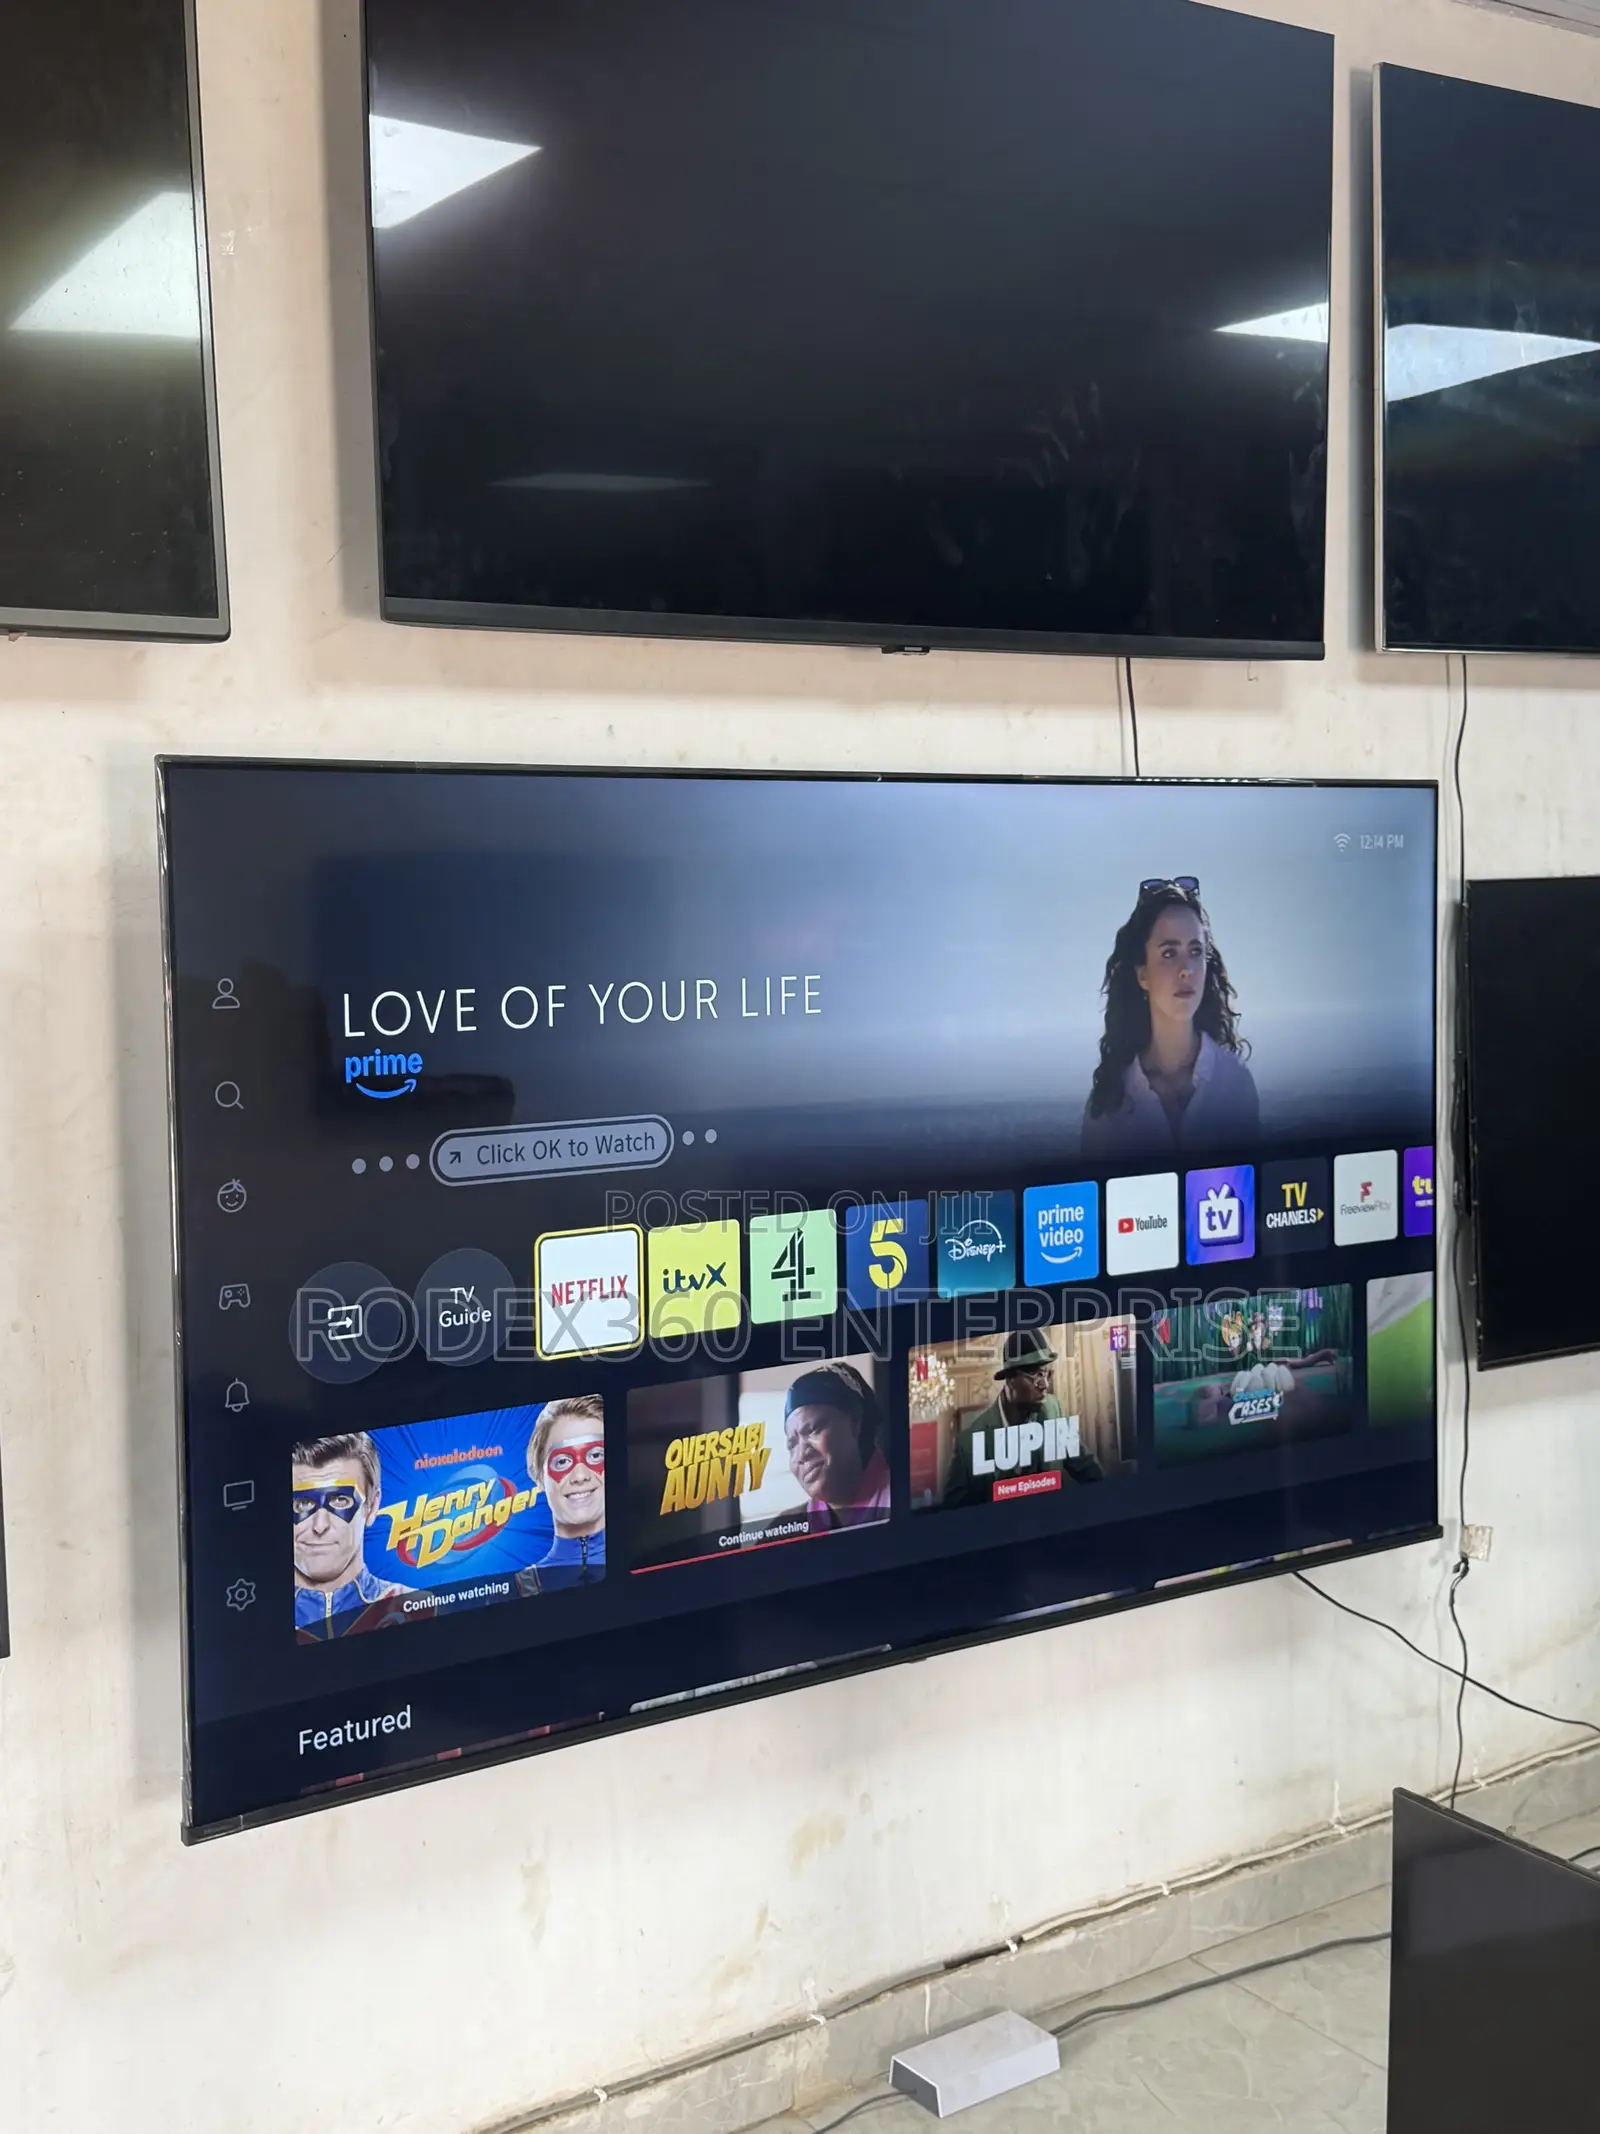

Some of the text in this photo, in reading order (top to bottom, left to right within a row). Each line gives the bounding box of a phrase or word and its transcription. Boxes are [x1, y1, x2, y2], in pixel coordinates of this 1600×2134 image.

[1360, 833, 1404, 850] 12:14 PM
[343, 974, 822, 1037] LOVE OF YOUR LIFE
[344, 1048, 424, 1083] prime
[476, 1131, 656, 1166] Click OK to Watch
[1281, 1181, 1308, 1208] TV
[1038, 1203, 1085, 1228] prime
[1135, 1214, 1168, 1232] YouTube
[1205, 1206, 1233, 1232] tv
[1266, 1208, 1317, 1229] CHANNELS
[1039, 1226, 1084, 1248] video
[771, 1227, 816, 1303] 4
[868, 1217, 908, 1290] 5
[551, 1274, 629, 1308] NETFLIX
[663, 1261, 727, 1295] itvX
[449, 1285, 475, 1304] TV
[439, 1307, 492, 1328] Guide
[1112, 1325, 1128, 1336] TOP
[1112, 1334, 1128, 1349] 10
[1228, 1396, 1273, 1426] CASES
[665, 1420, 766, 1470] OVERSABI
[971, 1414, 1081, 1477] LUPIN
[660, 1447, 772, 1516] AUNTY
[997, 1475, 1057, 1496] New Episodes
[376, 1476, 496, 1551] Henry
[399, 1486, 547, 1569] Danger
[718, 1520, 810, 1547] Continue watching
[402, 1581, 510, 1613] Continue watching
[298, 1704, 412, 1755] Featured
